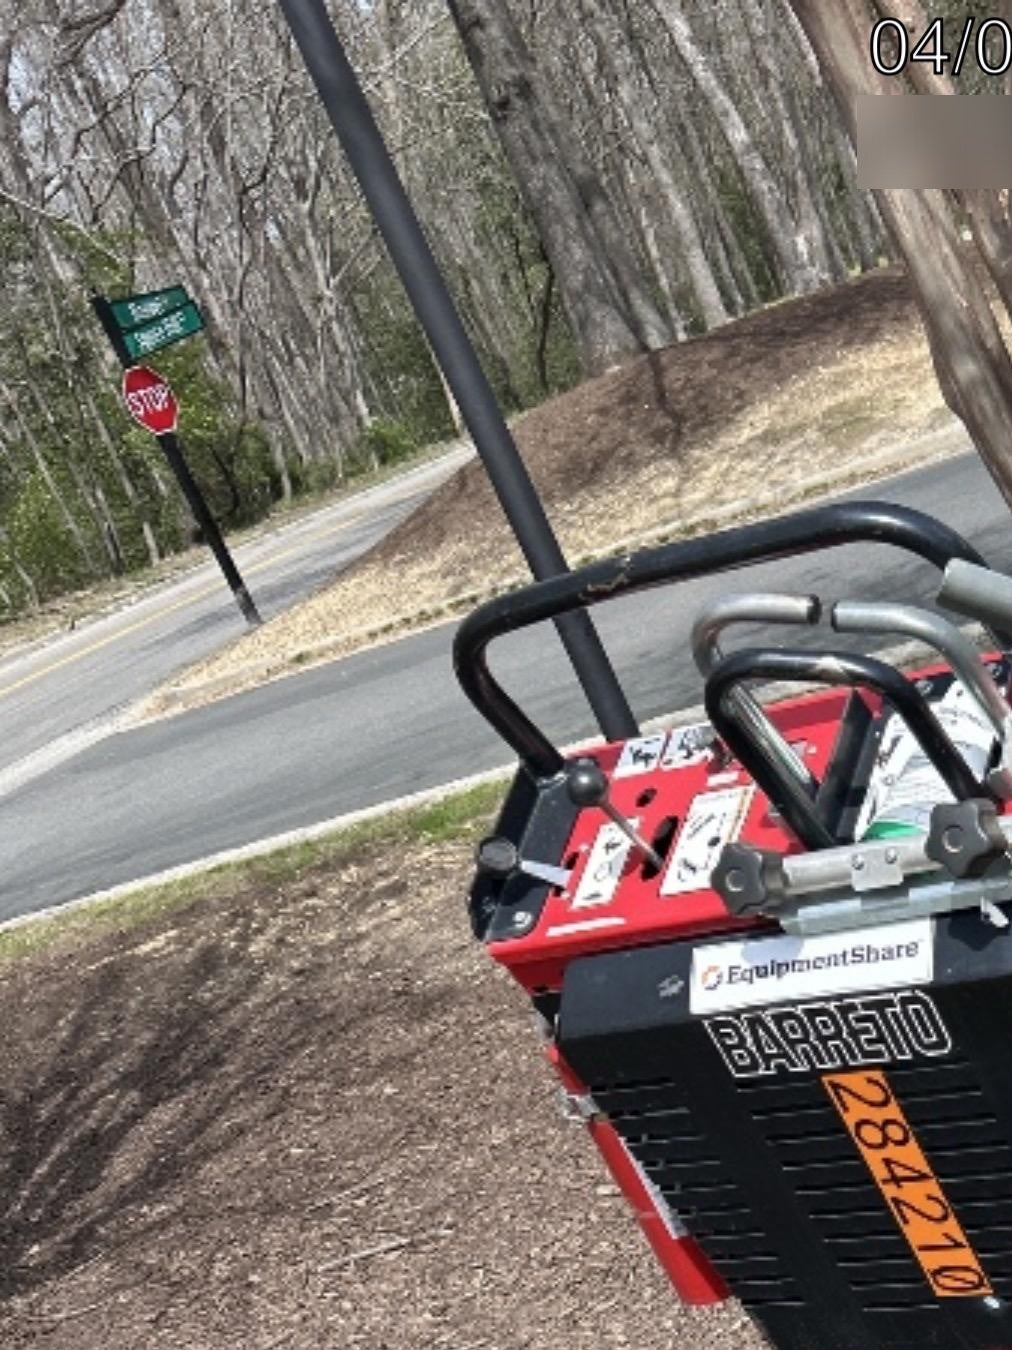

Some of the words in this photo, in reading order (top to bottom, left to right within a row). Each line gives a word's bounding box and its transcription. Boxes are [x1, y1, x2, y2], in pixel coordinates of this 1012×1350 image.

[127, 383, 169, 418] STOP
[727, 940, 919, 984] EquipmentShare
[702, 989, 951, 1078] BARRETO
[828, 1076, 985, 1292] 284210
